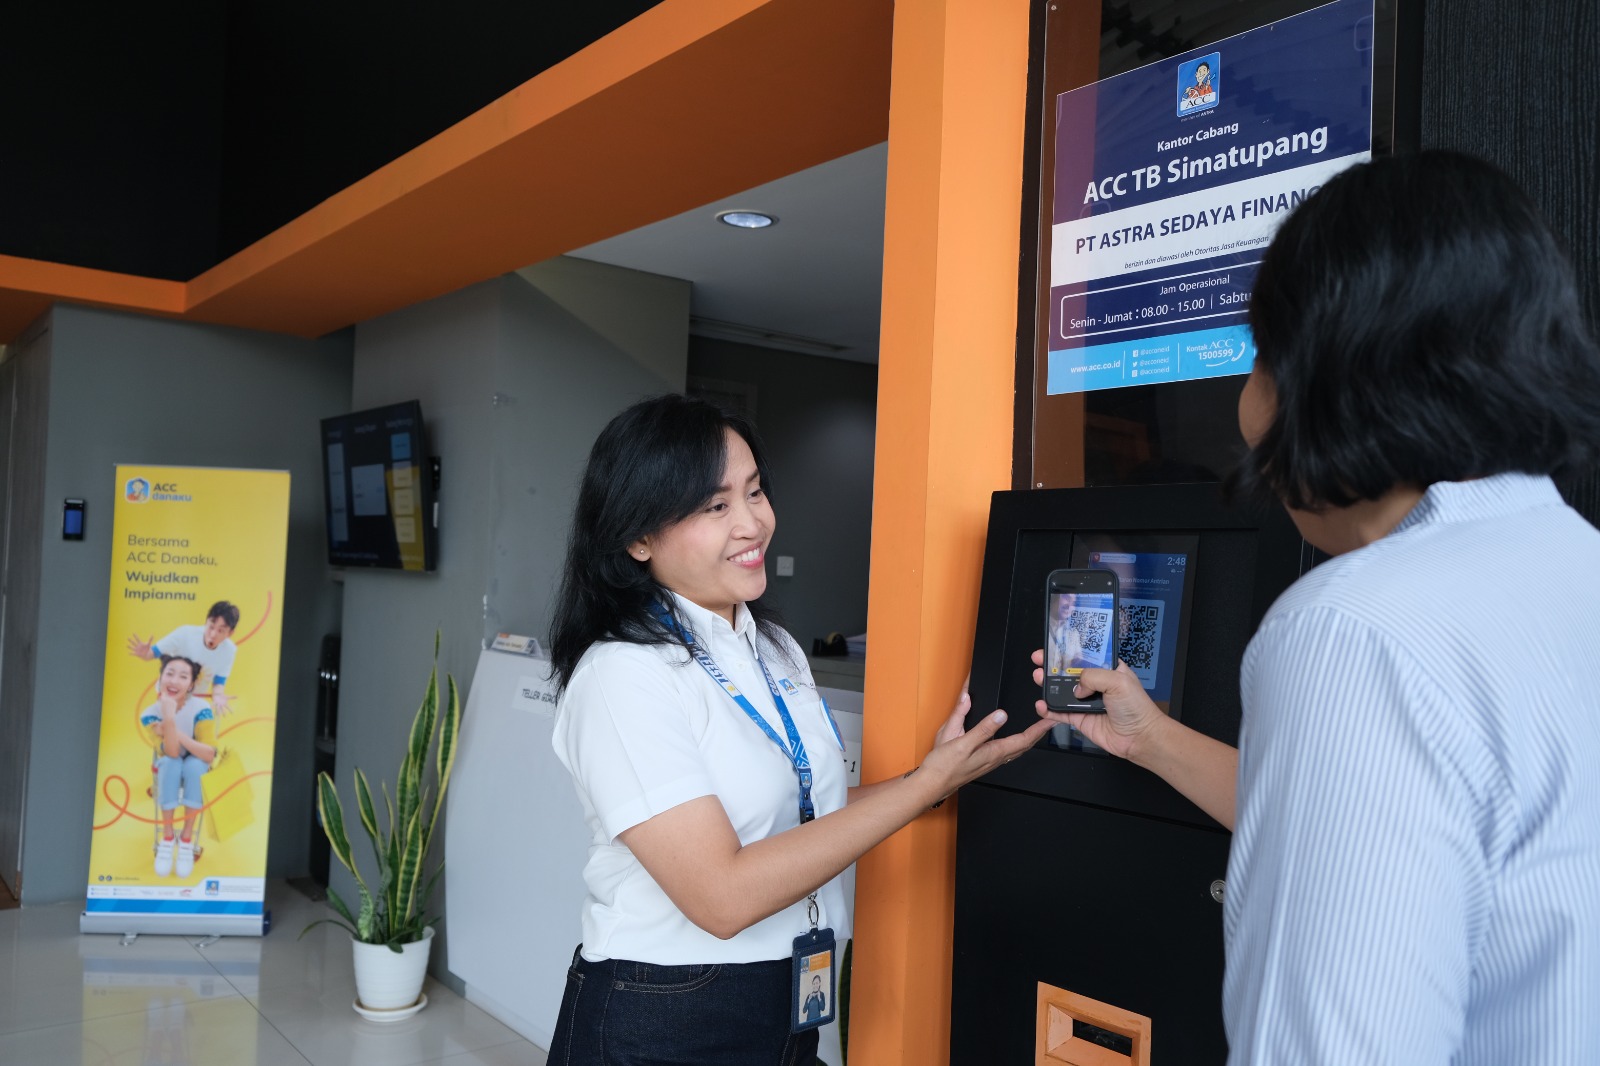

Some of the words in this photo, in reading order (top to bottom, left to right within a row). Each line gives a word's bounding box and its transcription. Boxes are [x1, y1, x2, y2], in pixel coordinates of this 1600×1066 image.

[1186, 94, 1211, 108] ACC
[1157, 134, 1193, 152] Kantor
[1195, 122, 1239, 142] Cabang
[1083, 172, 1127, 204] ACC
[1132, 165, 1161, 192] TB
[1167, 126, 1328, 183] Simatupang
[1076, 235, 1096, 254] PT
[1099, 222, 1155, 250] ASTRA
[1160, 204, 1236, 237] SEDAYA
[1124, 259, 1144, 269] berizin
[1144, 257, 1156, 266] dan
[1156, 253, 1180, 263] diawasi
[1180, 250, 1194, 259] oleh
[1194, 245, 1220, 256] Otoritas
[1220, 241, 1235, 251] Jasa
[1235, 236, 1269, 248] Keuangan
[1160, 286, 1176, 296] Jam
[1178, 274, 1230, 293] Operasional
[1070, 316, 1095, 329] Senin
[1103, 311, 1133, 325] Jumat
[1141, 303, 1168, 319] 08.00
[1178, 298, 1205, 313] 15.00
[1186, 343, 1208, 353] Kontak
[1208, 338, 1234, 349] ACC
[1198, 348, 1234, 360] 1500599
[1070, 360, 1121, 374] www.acc.co.id
[153, 483, 177, 492] ACC
[152, 492, 193, 502] danaku
[127, 534, 189, 548] Bersama
[126, 552, 156, 564] ACC
[160, 552, 218, 567] Danaku,
[1167, 557, 1186, 566] 2:48
[125, 571, 199, 585] Wujudkan
[124, 588, 196, 602] Impianmu
